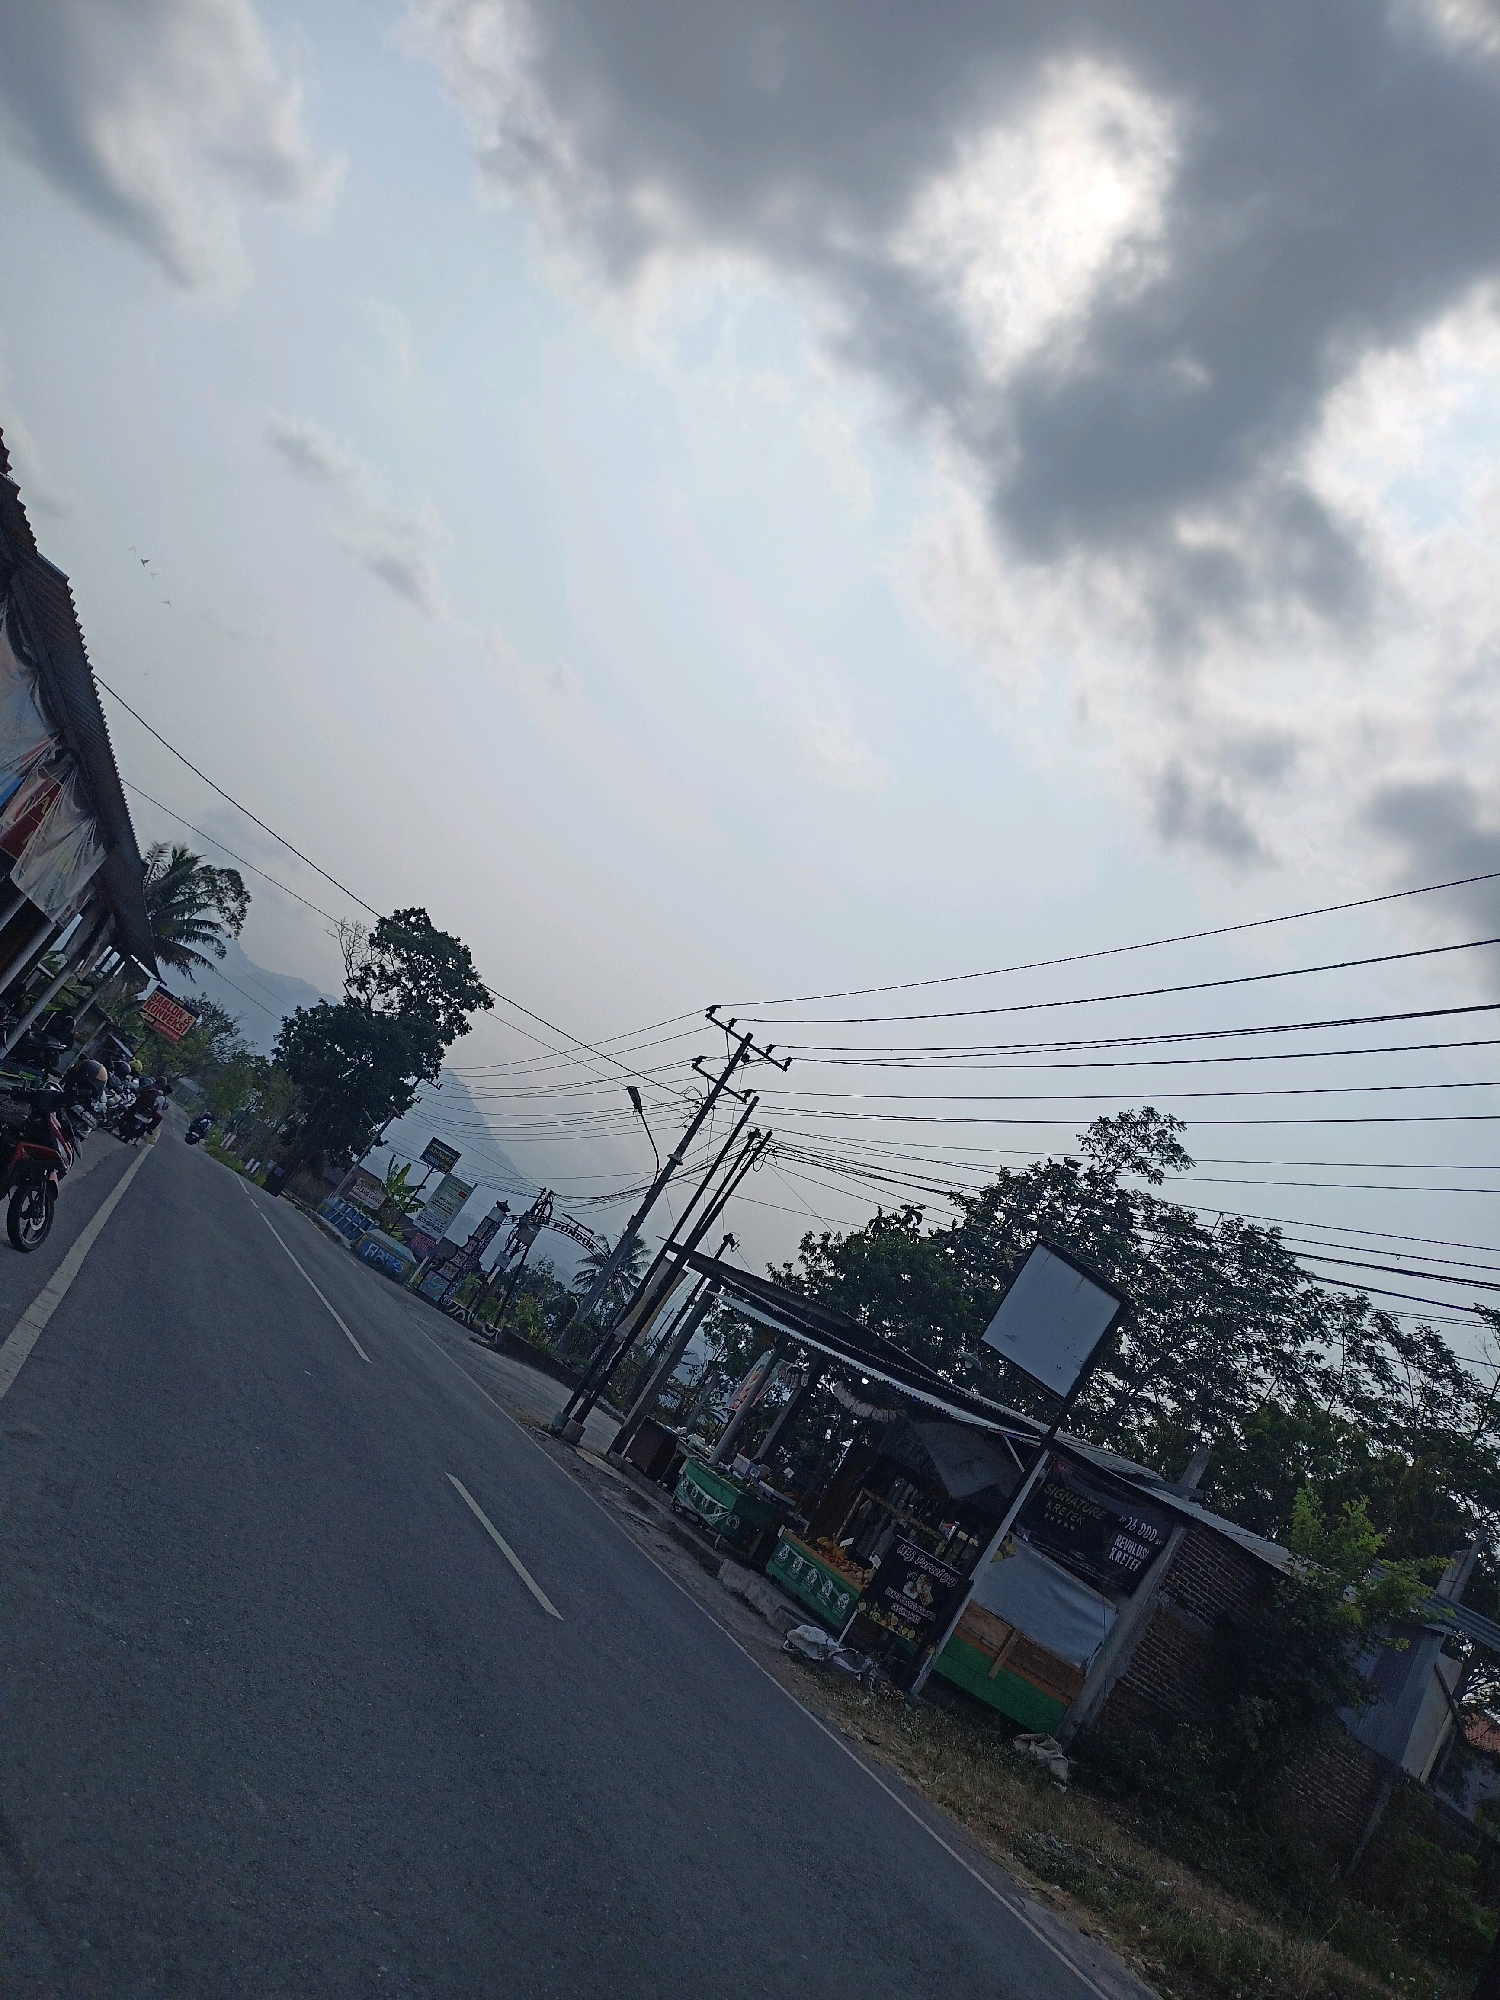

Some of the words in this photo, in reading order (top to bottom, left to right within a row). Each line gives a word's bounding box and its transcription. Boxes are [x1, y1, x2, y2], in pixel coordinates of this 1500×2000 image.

[144, 1000, 188, 1033] KONVEKSI
[151, 992, 183, 1020] SABLON
[184, 1015, 193, 1026] &
[1044, 1483, 1107, 1520] SIGNATURE
[1046, 1500, 1085, 1525] KRETEK
